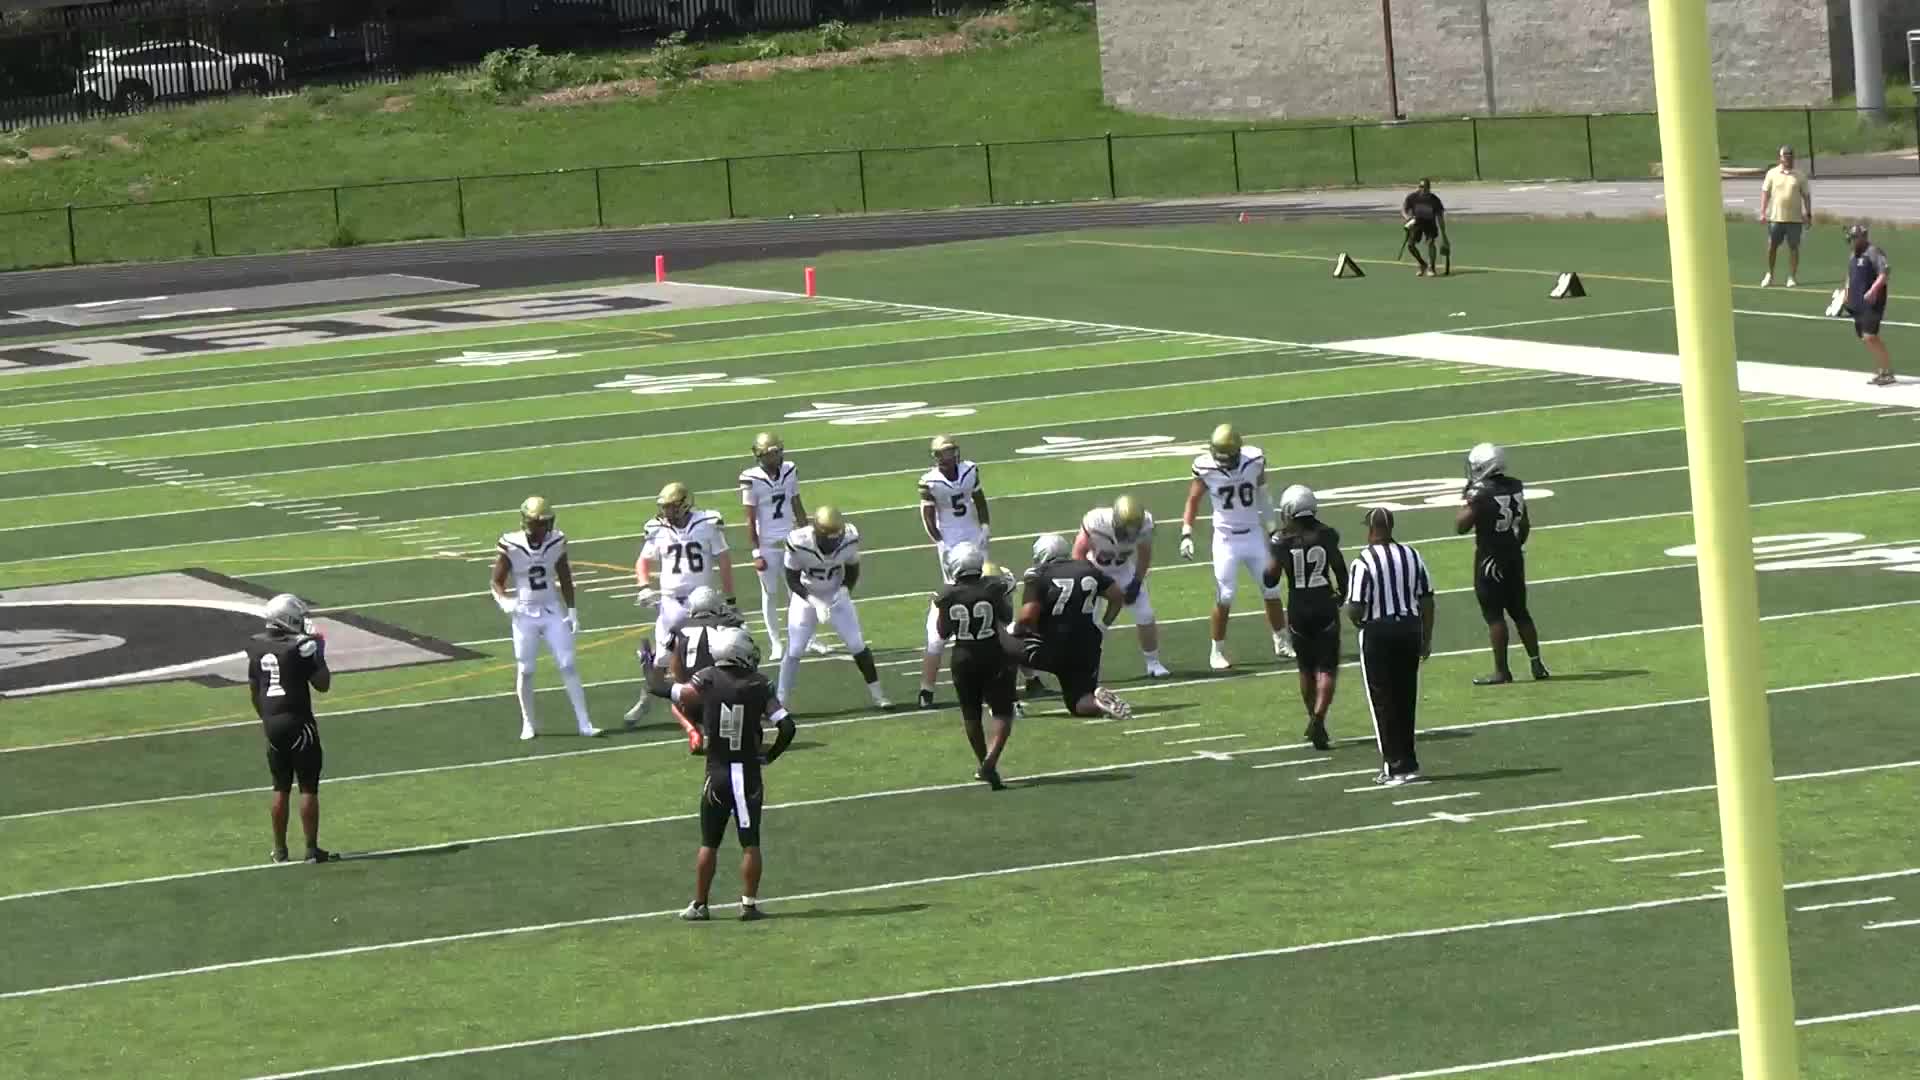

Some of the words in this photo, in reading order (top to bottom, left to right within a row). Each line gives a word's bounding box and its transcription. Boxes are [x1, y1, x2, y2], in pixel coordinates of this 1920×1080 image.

[771, 493, 786, 519] 7
[951, 493, 967, 517] 5
[1217, 481, 1255, 511] 70
[667, 541, 704, 575] 76
[1289, 545, 1329, 589] 12
[528, 565, 548, 592] 2
[1052, 575, 1098, 616] 72
[950, 601, 996, 641] 22
[719, 702, 745, 751] 4
